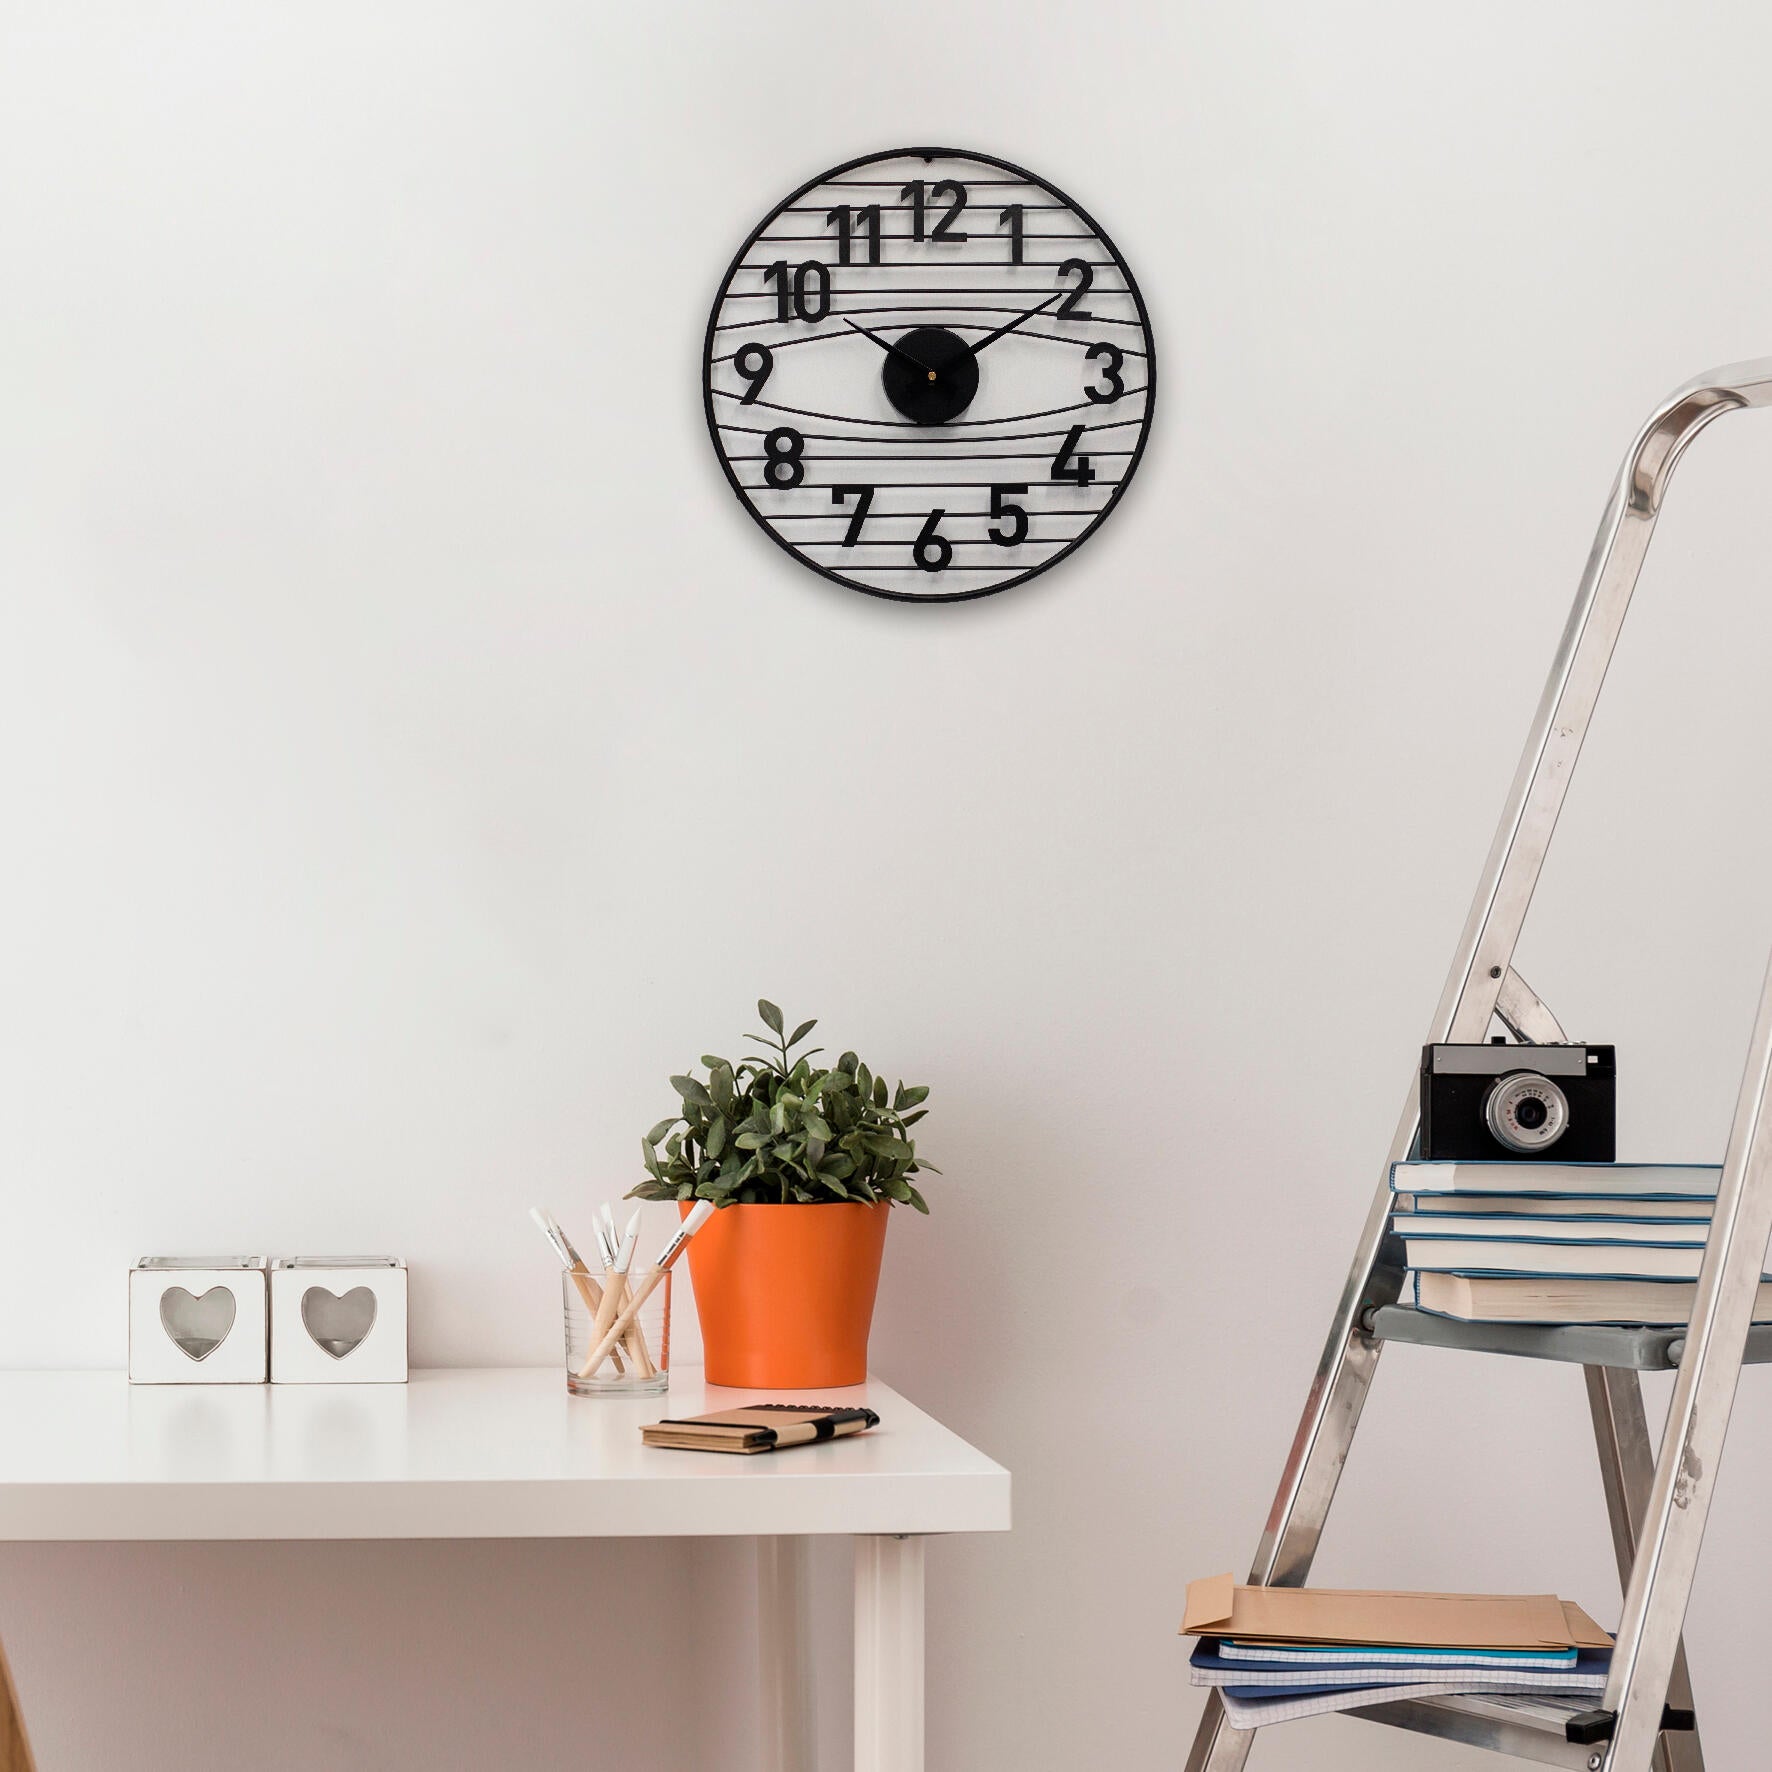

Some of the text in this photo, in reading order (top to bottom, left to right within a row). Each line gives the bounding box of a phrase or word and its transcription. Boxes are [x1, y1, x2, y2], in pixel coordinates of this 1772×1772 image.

[827, 205, 880, 266] 11
[901, 180, 967, 242] 12
[1000, 204, 1022, 264] 1
[764, 261, 830, 323] 10
[1057, 259, 1093, 321] 2
[734, 343, 773, 405] 9
[1084, 342, 1124, 404] 3
[764, 427, 804, 489] 8
[1051, 425, 1095, 487] 4
[832, 485, 874, 547] 7
[913, 509, 952, 572] 6
[988, 485, 1028, 546] 5
